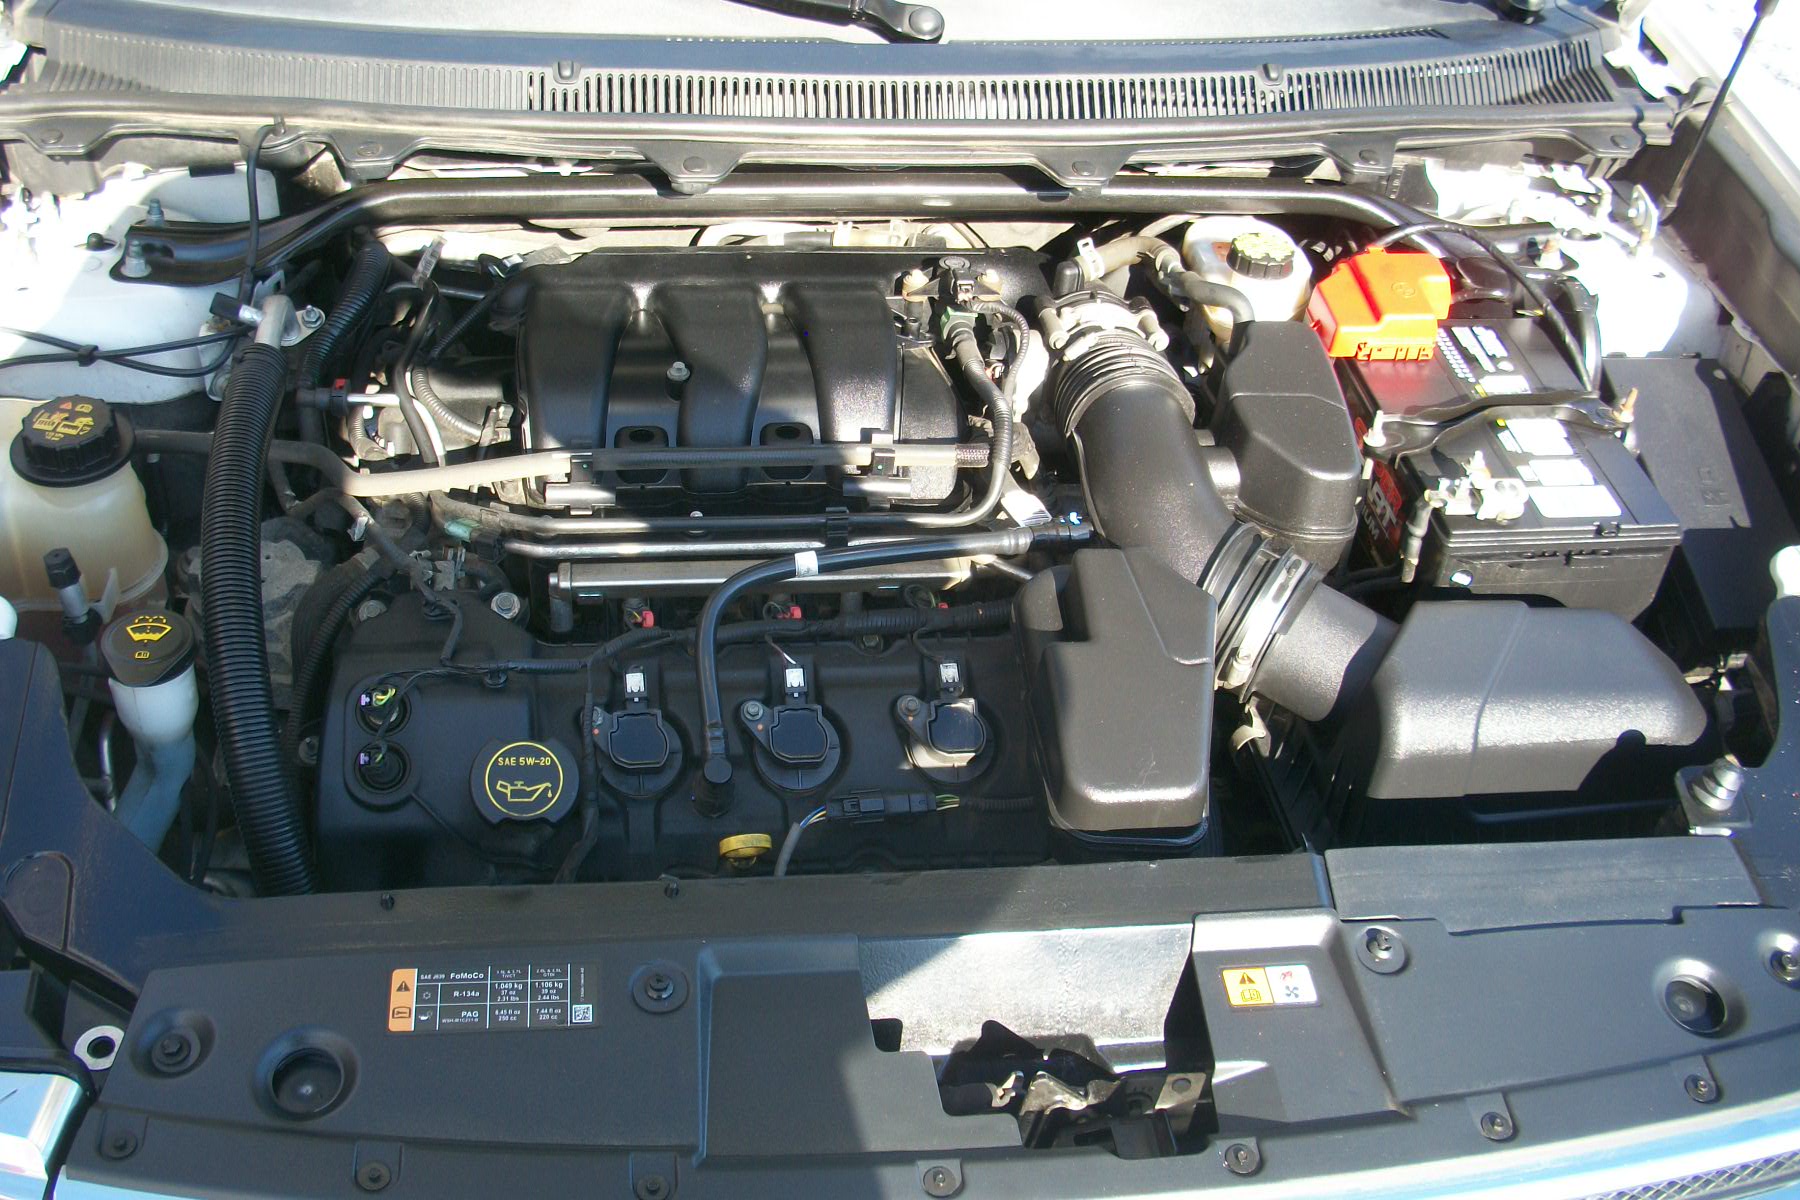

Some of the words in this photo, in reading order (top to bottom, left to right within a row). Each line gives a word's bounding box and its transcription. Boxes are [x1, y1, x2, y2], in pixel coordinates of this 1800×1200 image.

[498, 757, 517, 766] SAE
[519, 757, 551, 766] 5W-20
[450, 972, 484, 980] FoMoCo
